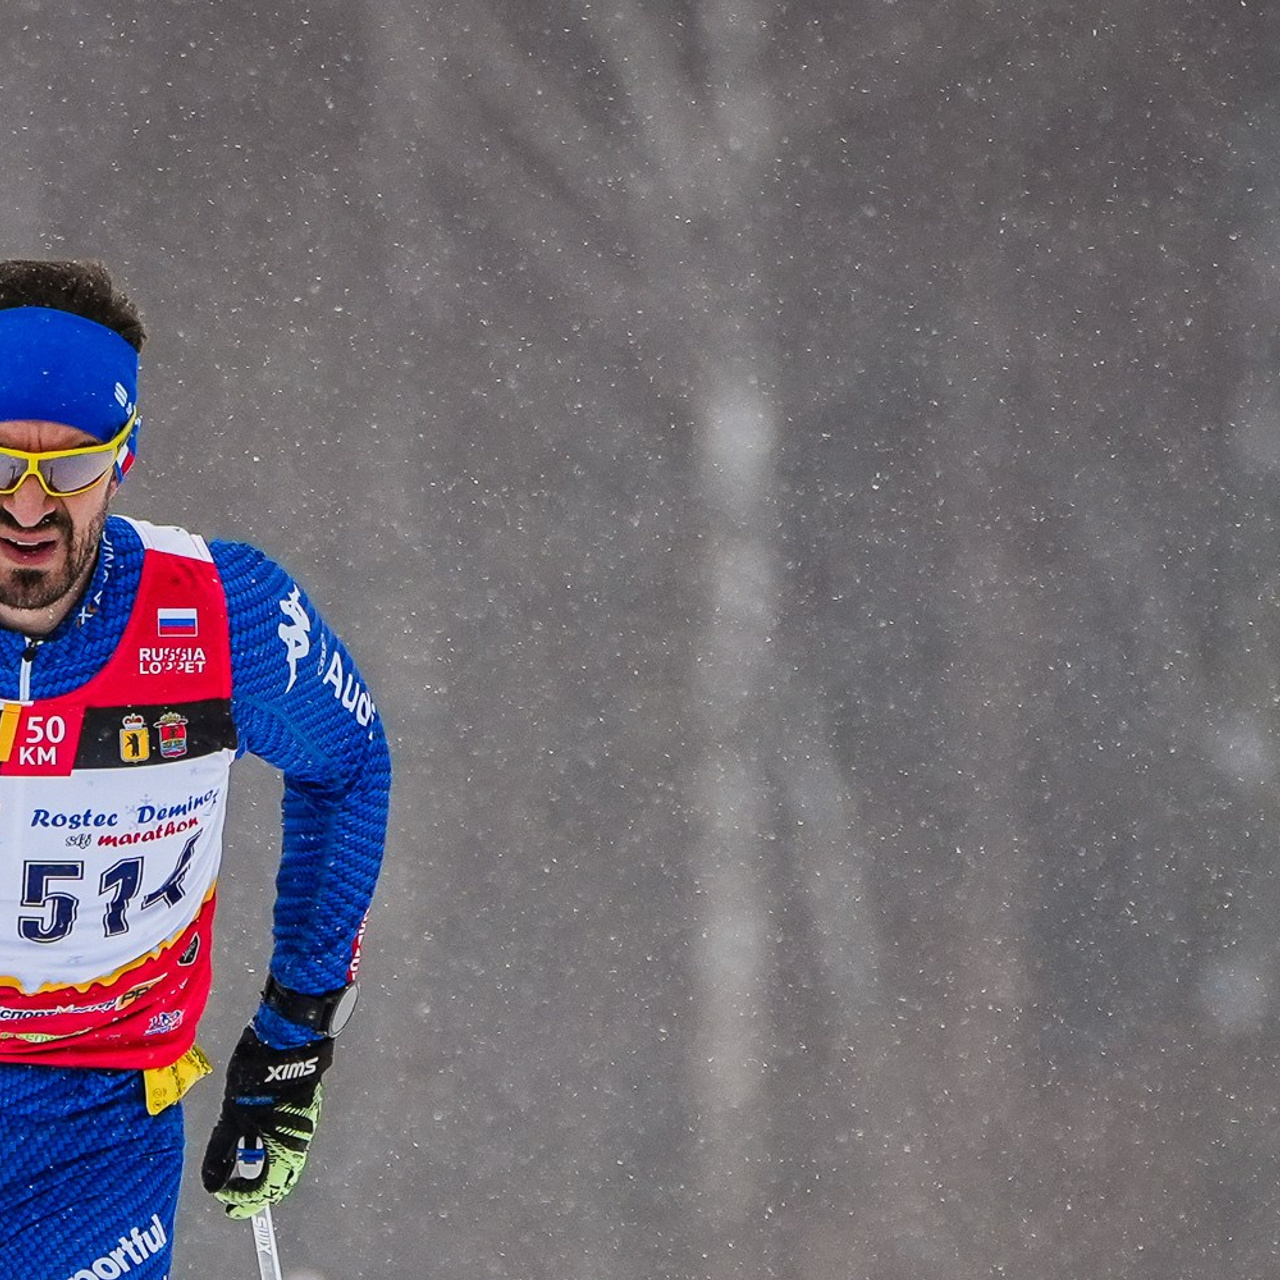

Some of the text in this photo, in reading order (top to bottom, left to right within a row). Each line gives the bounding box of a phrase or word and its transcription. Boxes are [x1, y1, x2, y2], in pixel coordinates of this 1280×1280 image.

[139, 647, 206, 662] RUSSIA
[25, 715, 66, 744] 50
[19, 746, 57, 766] KM
[30, 808, 119, 830] Rostec
[97, 816, 200, 848] marathon
